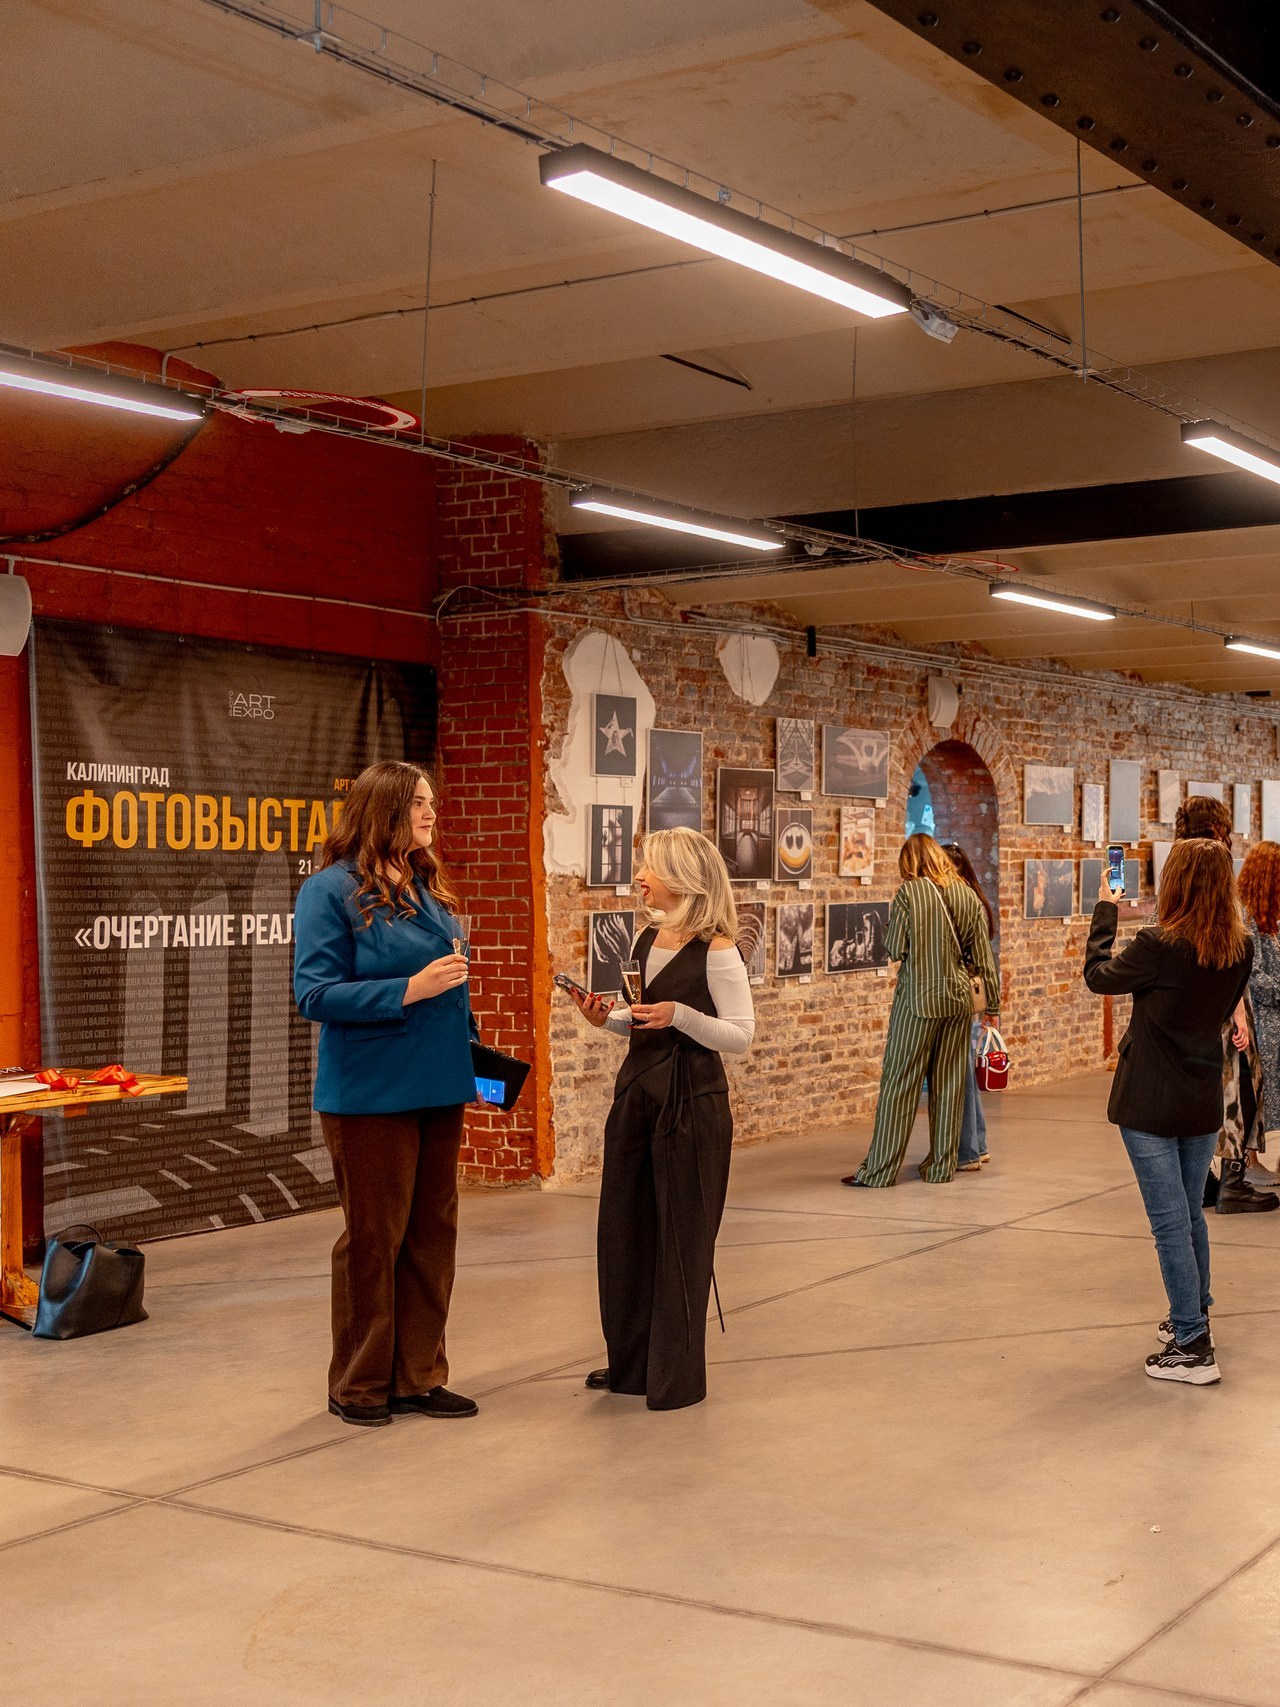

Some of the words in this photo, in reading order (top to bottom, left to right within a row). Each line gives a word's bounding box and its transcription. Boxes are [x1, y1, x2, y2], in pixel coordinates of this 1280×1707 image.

[233, 692, 276, 709] ART
[232, 706, 275, 720] EXPO
[66, 762, 170, 788] КАЛИНИНГРАД
[334, 778, 350, 791] АРТ
[298, 859, 312, 875] 21
[74, 914, 236, 950] «ОЧЕРТАНИЕ
